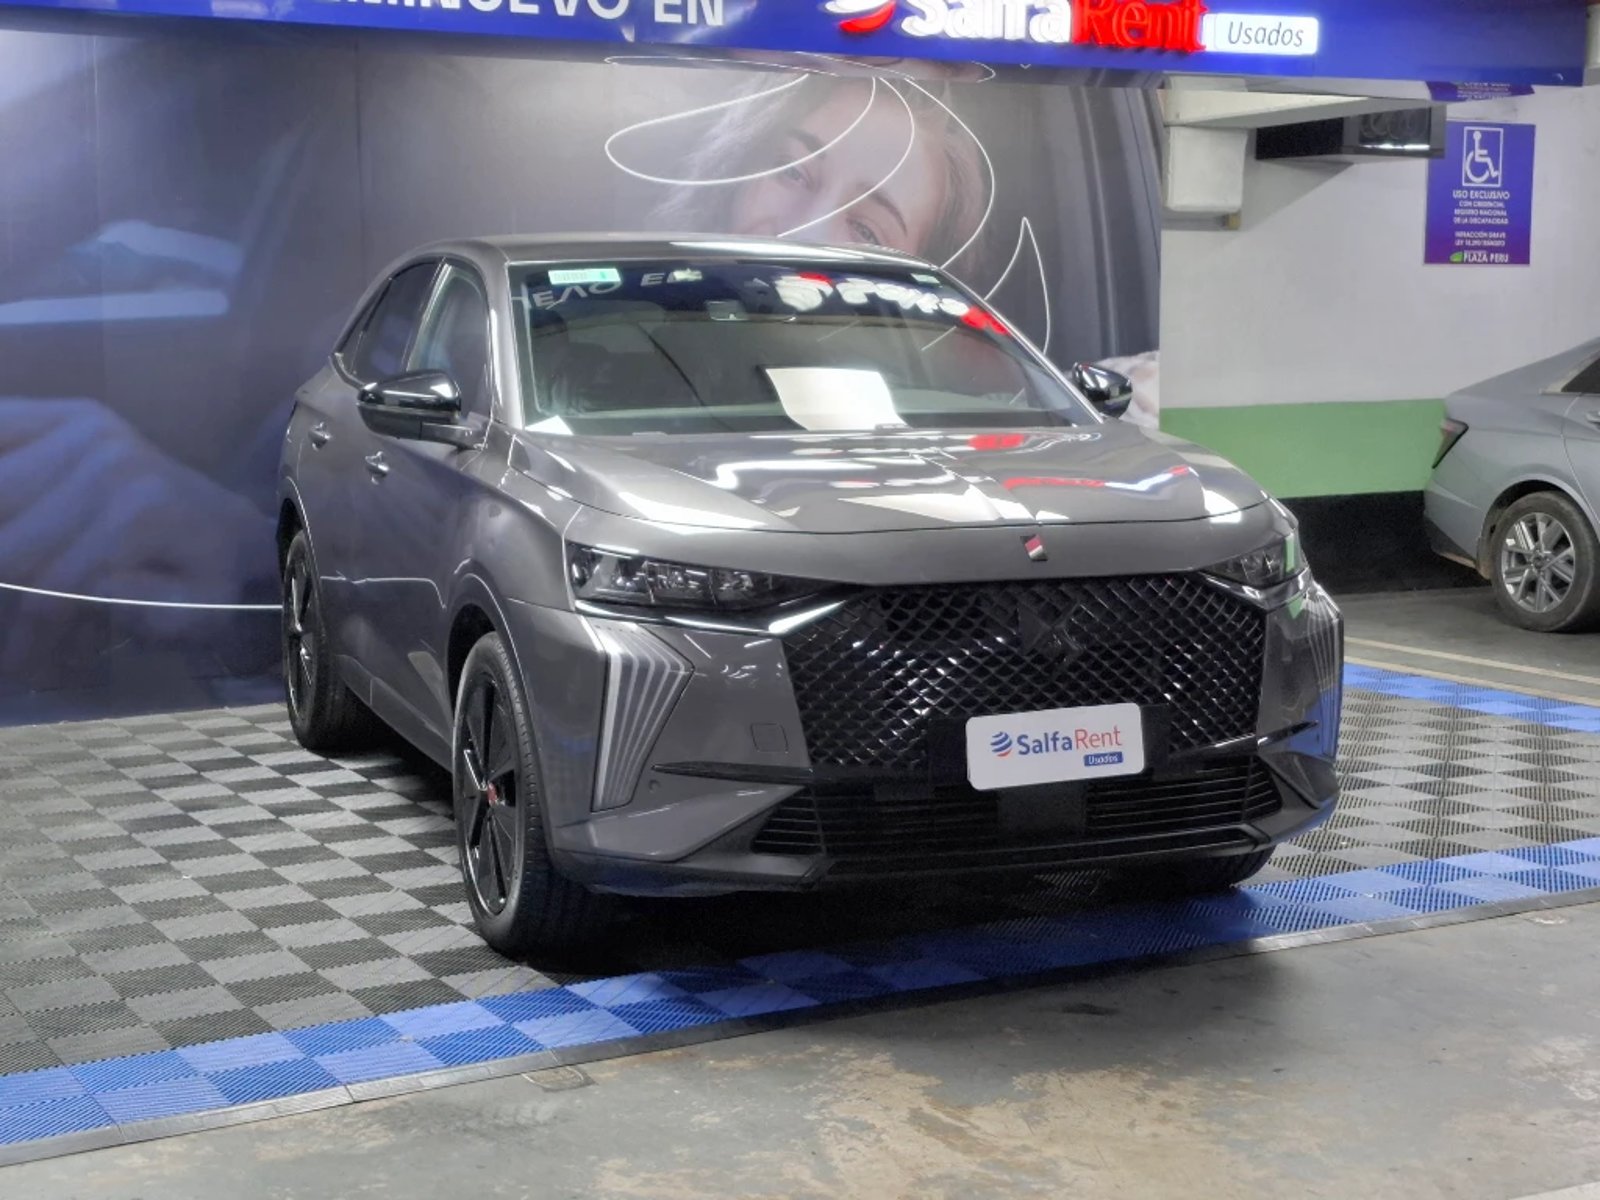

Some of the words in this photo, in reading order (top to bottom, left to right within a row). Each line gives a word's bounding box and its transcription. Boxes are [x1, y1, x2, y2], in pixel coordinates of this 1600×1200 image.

[654, 0, 724, 26] EN
[1228, 21, 1304, 47] Usados
[1453, 190, 1468, 199] USO
[1470, 190, 1510, 200] EXCLUSIVO
[1464, 251, 1488, 263] PLAZA
[1017, 726, 1122, 755] SalfaRent
[1089, 753, 1118, 765] Usados
